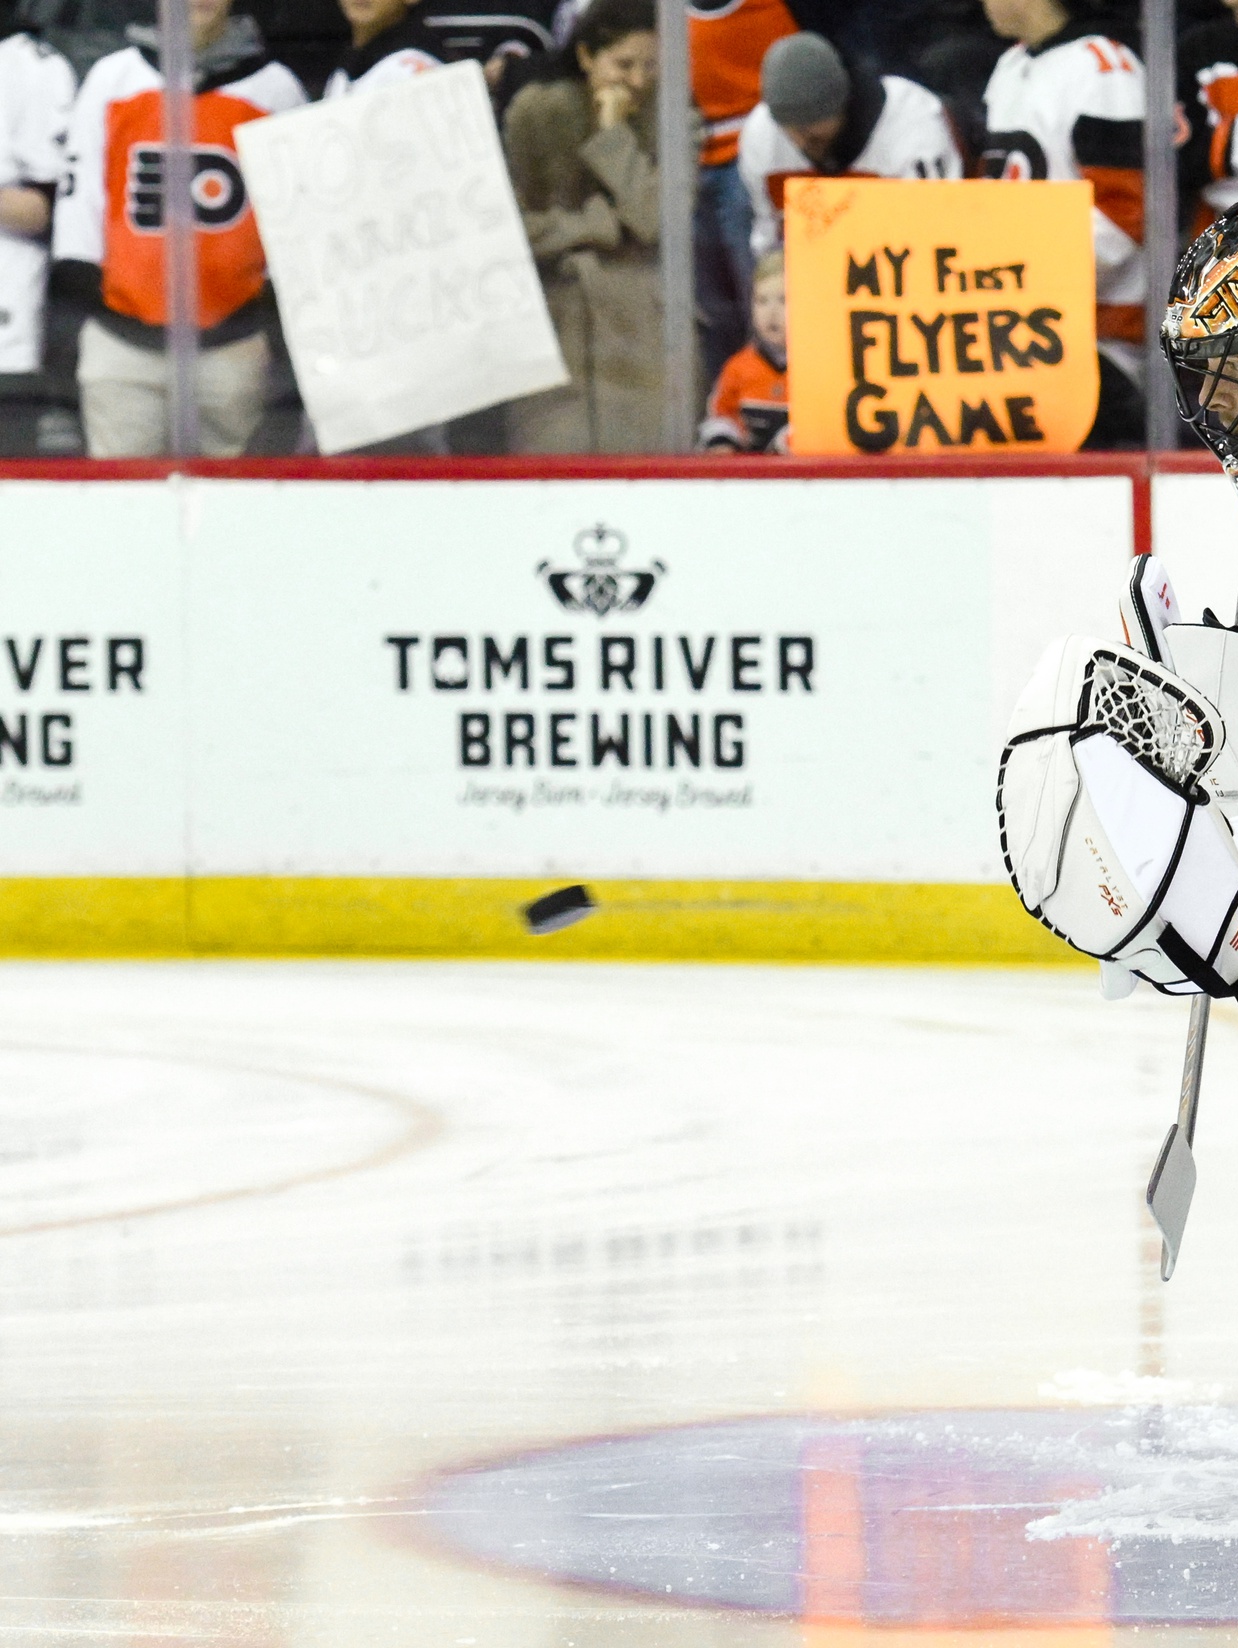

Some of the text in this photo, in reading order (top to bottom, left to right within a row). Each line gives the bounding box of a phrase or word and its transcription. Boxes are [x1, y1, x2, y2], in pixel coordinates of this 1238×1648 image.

[846, 246, 910, 297] MY
[849, 307, 1064, 382] FLYERS
[846, 382, 1045, 455] GAME
[384, 635, 815, 693] TOMS RIVER
[459, 711, 745, 770] BREWING
